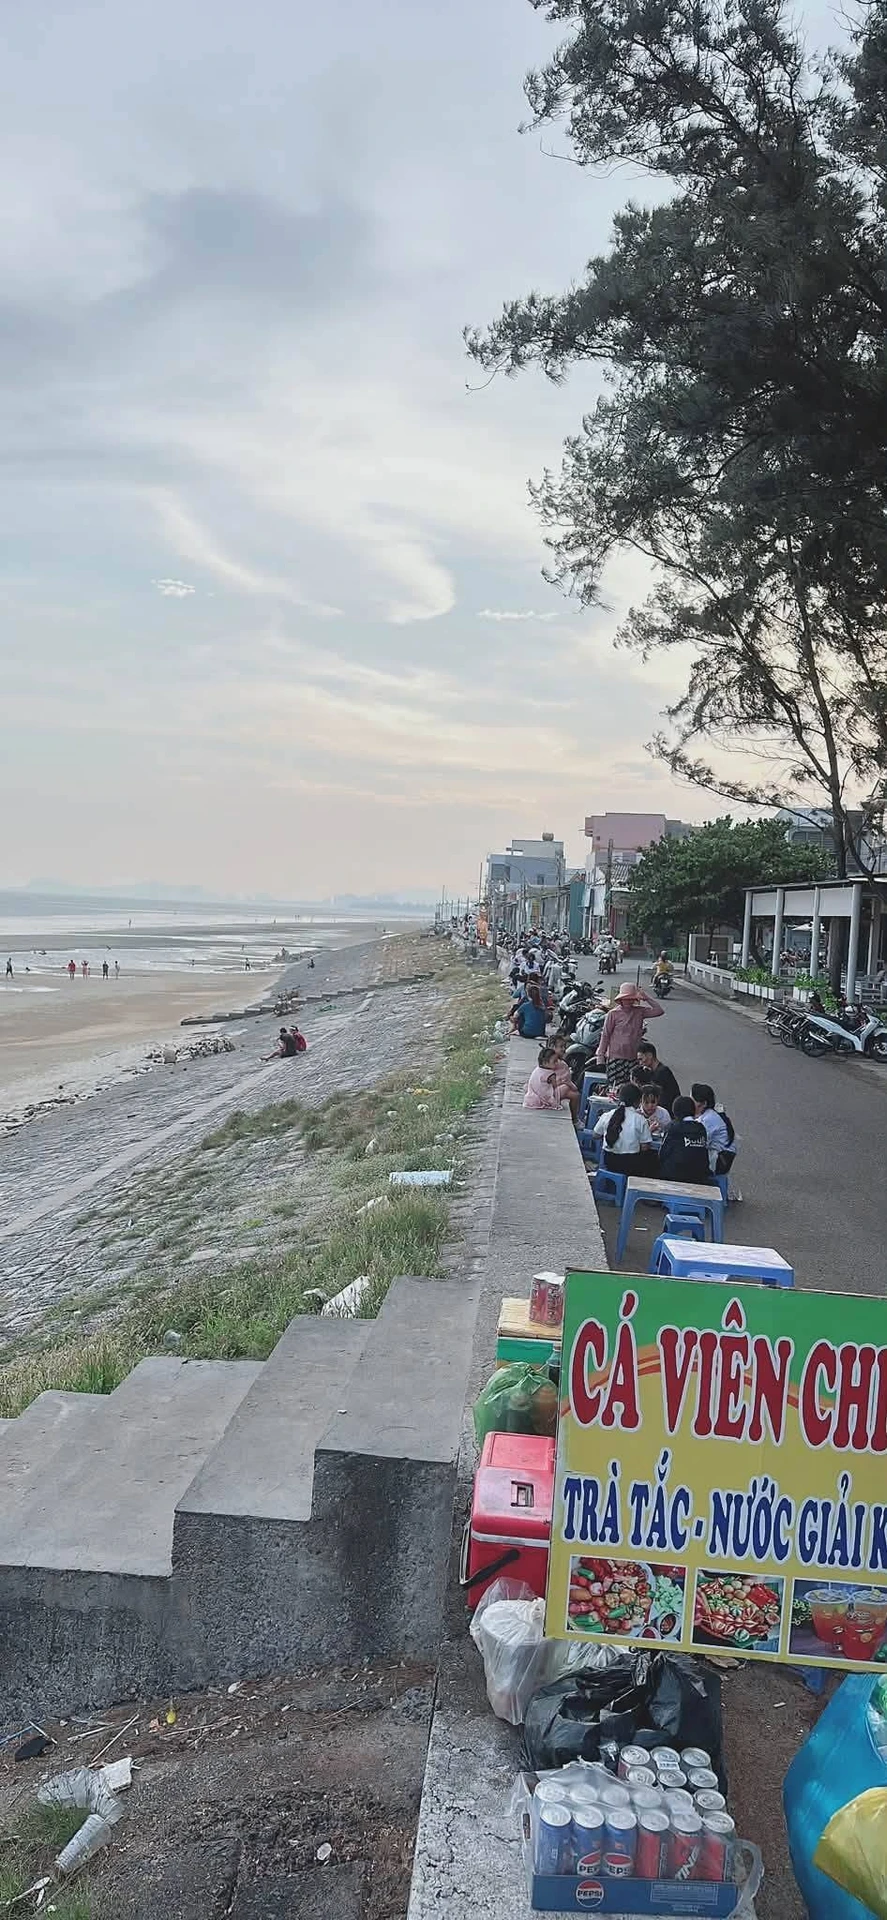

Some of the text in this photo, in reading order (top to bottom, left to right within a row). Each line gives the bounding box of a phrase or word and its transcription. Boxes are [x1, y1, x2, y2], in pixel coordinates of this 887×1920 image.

[571, 1292, 640, 1429] CÁ
[659, 1299, 792, 1444] VIÊN
[563, 1461, 620, 1544] TRÀ
[630, 1450, 690, 1550] TẮC
[694, 1519, 704, 1537] -
[708, 1476, 793, 1561] NƯỚC
[799, 1473, 866, 1568] GIẢI
[577, 1889, 603, 1897] PEPSI
